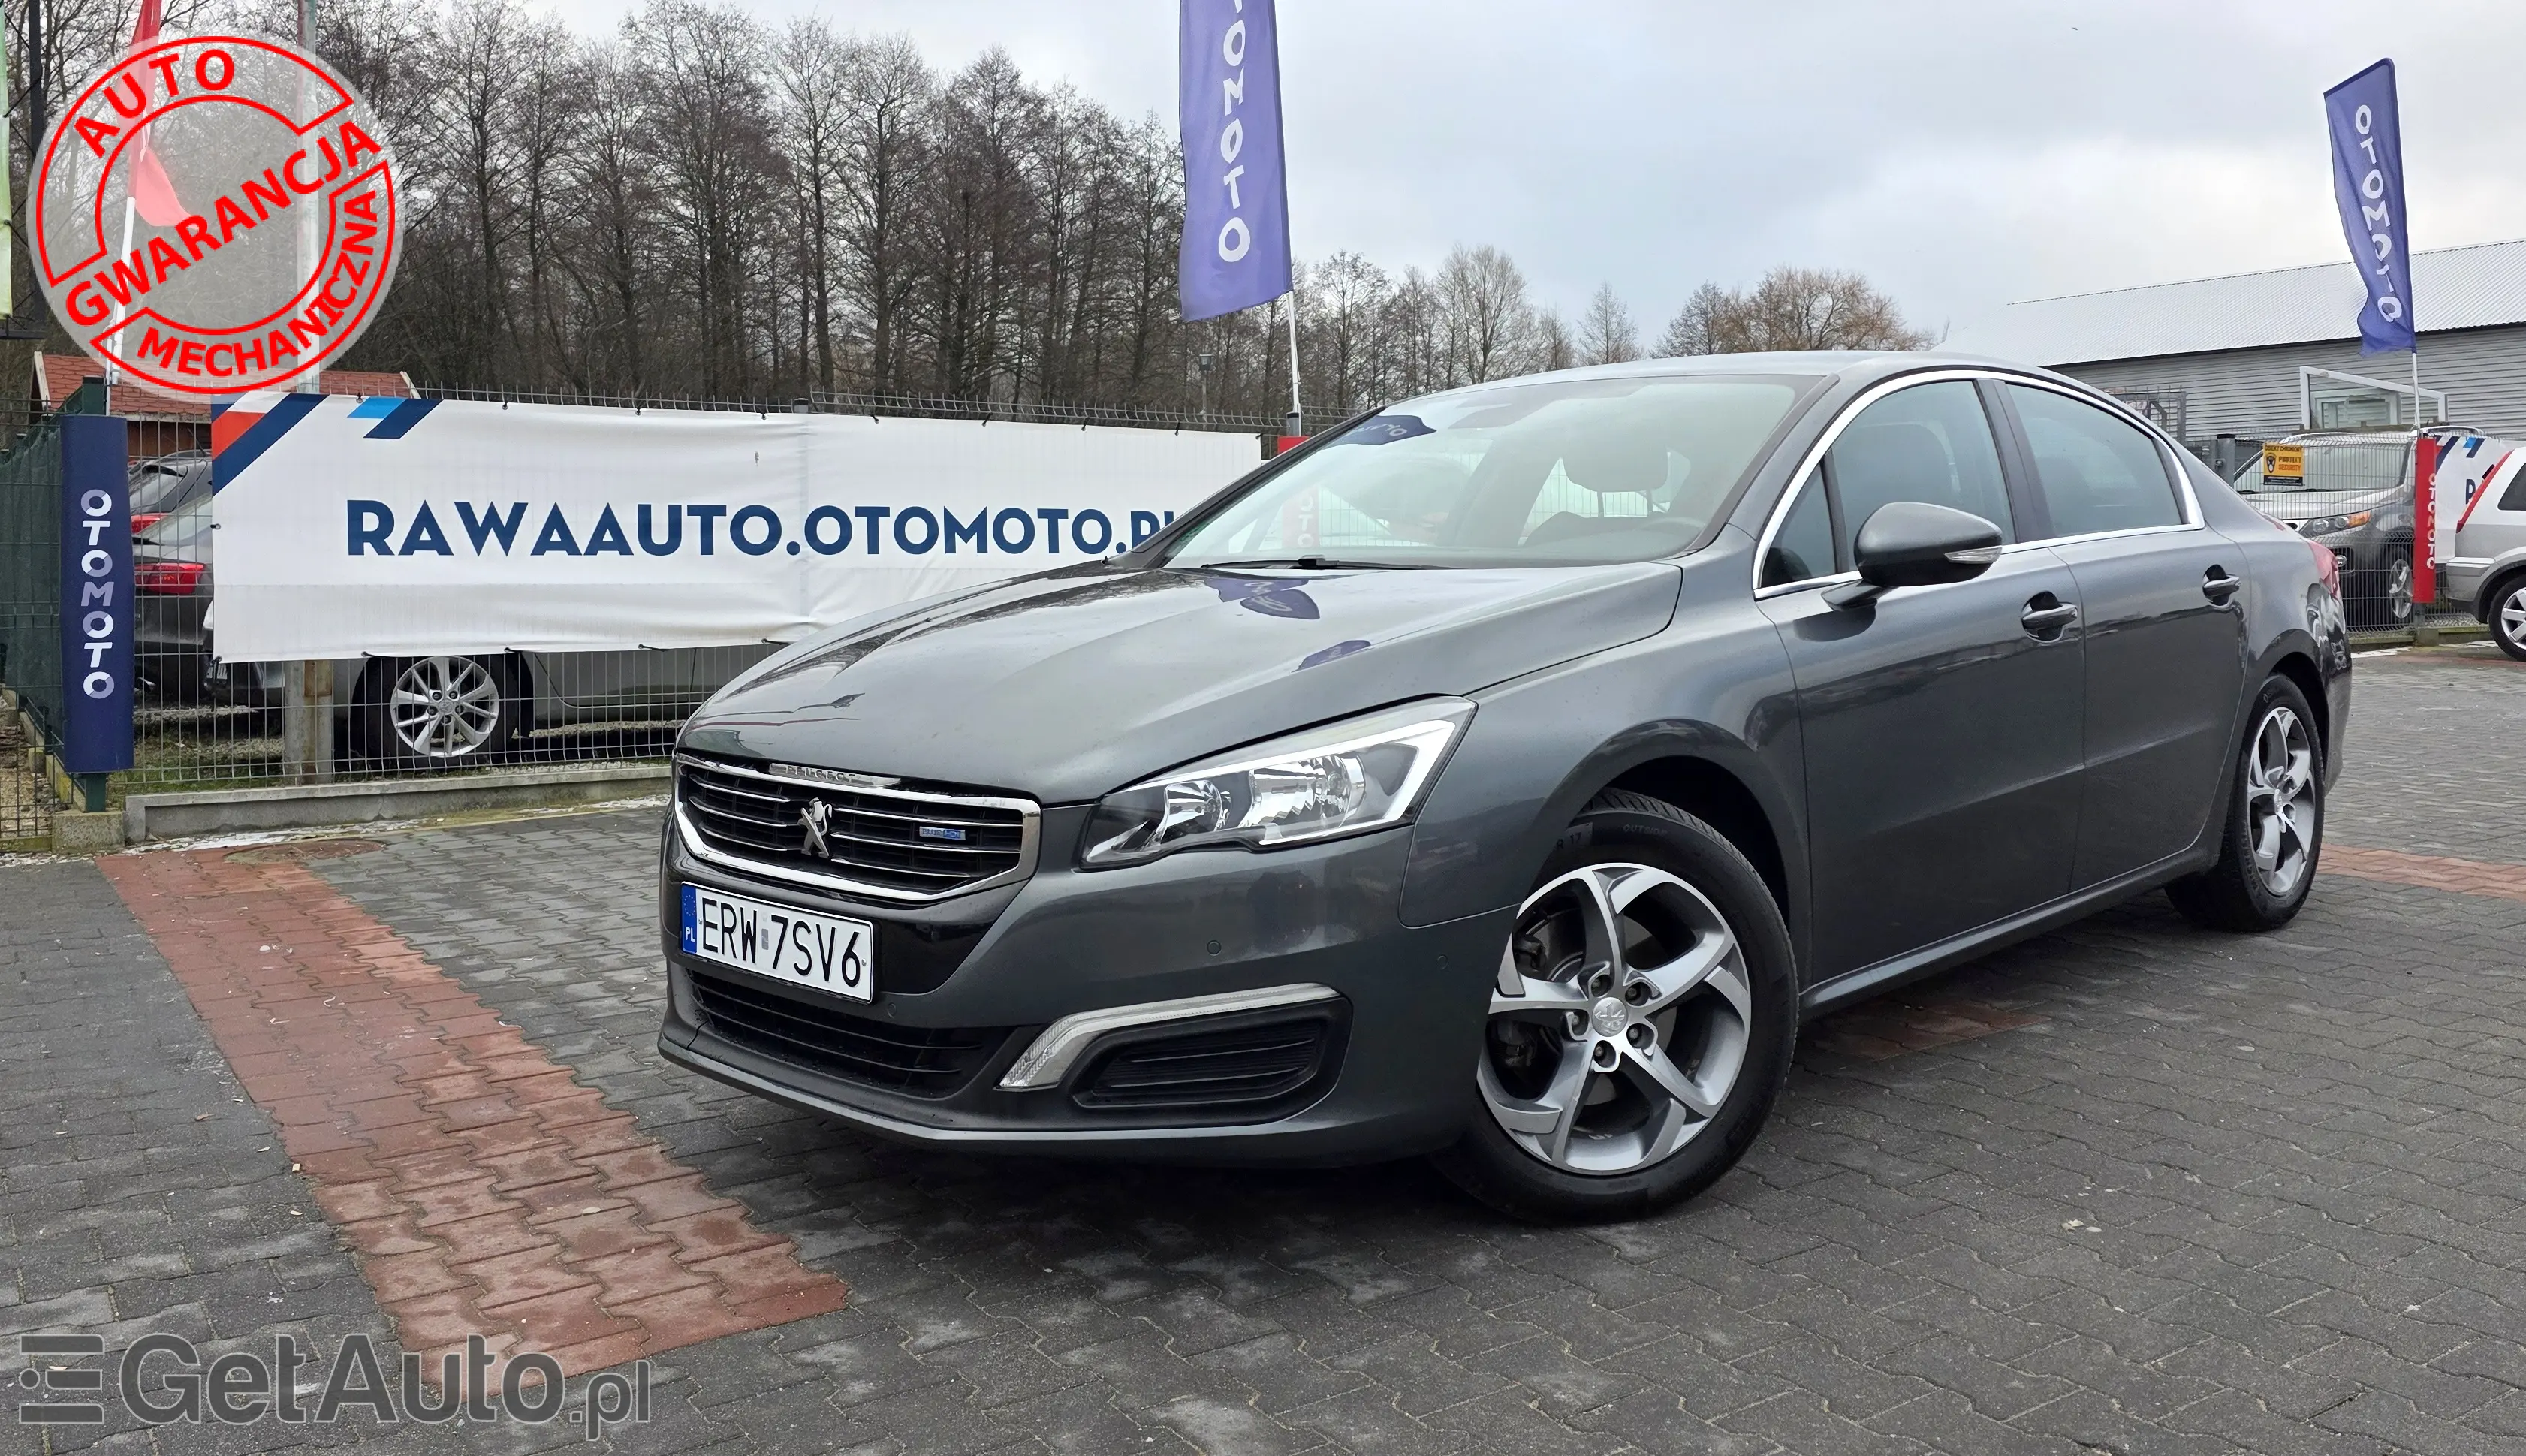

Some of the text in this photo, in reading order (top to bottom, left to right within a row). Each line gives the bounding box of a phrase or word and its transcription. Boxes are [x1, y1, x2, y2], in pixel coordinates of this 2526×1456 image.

[2355, 104, 2402, 322] OTOMOTO
[80, 489, 114, 698] OTOMOTO
[685, 927, 695, 942] PL
[702, 897, 861, 988] ERW 7SV6
